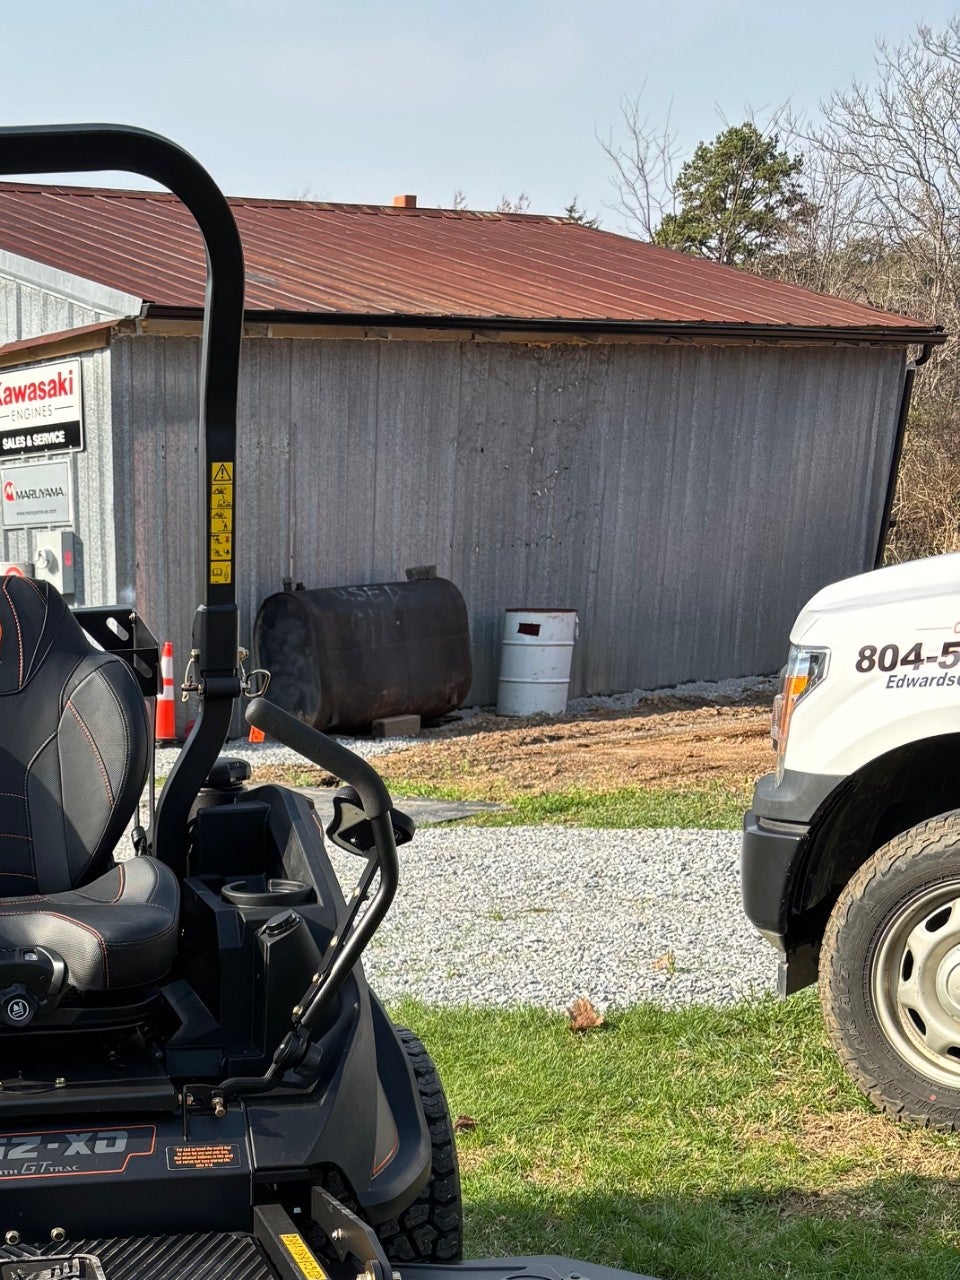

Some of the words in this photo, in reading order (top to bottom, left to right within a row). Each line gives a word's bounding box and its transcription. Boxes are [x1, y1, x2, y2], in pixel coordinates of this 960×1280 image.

[11, 404, 53, 422] ENGINES
[2, 435, 26, 450] SALES
[26, 434, 33, 447] &
[32, 430, 66, 446] SERVICE
[16, 486, 65, 500] MARUYAMA
